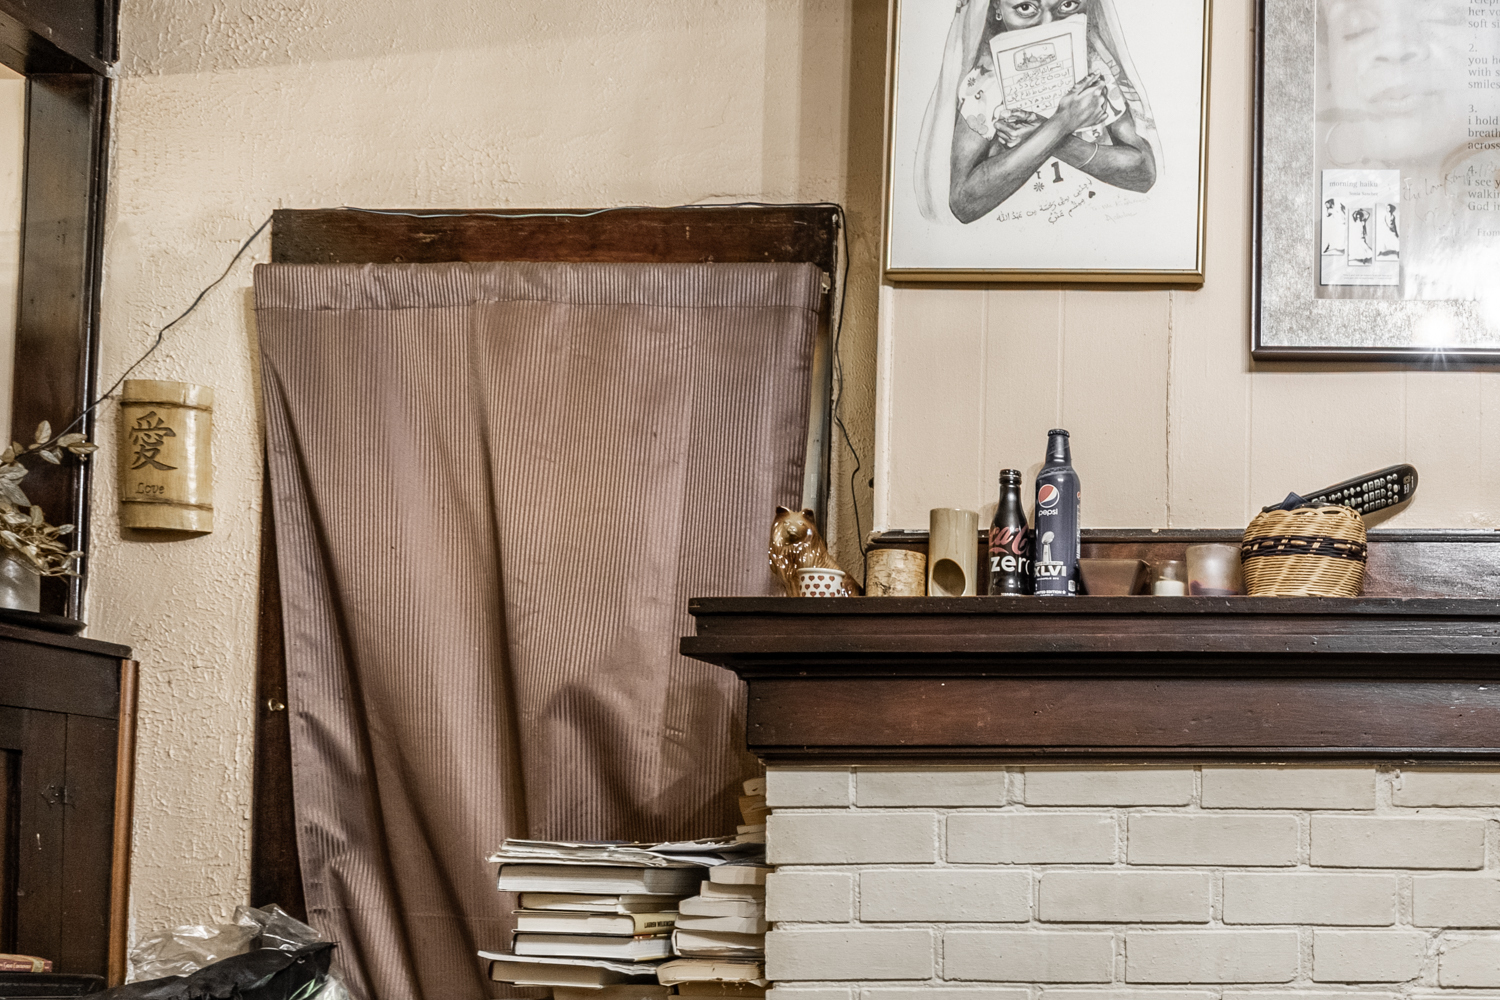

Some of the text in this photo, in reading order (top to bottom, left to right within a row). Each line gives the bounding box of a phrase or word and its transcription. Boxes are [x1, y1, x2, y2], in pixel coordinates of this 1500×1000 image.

[1468, 7, 1486, 17] her
[1468, 19, 1487, 29] soft
[1468, 57, 1488, 66] you
[1468, 67, 1491, 77] with
[1468, 79, 1500, 90] smiles
[1468, 104, 1478, 113] 3.
[1475, 115, 1499, 126] hold
[1468, 128, 1500, 138] breath
[1468, 142, 1500, 150] across
[1359, 180, 1379, 188] haiku
[1475, 179, 1492, 187] see
[1468, 201, 1489, 211] God
[128, 410, 178, 471] 愛
[135, 482, 165, 494] Love
[1038, 508, 1058, 517] pepsi
